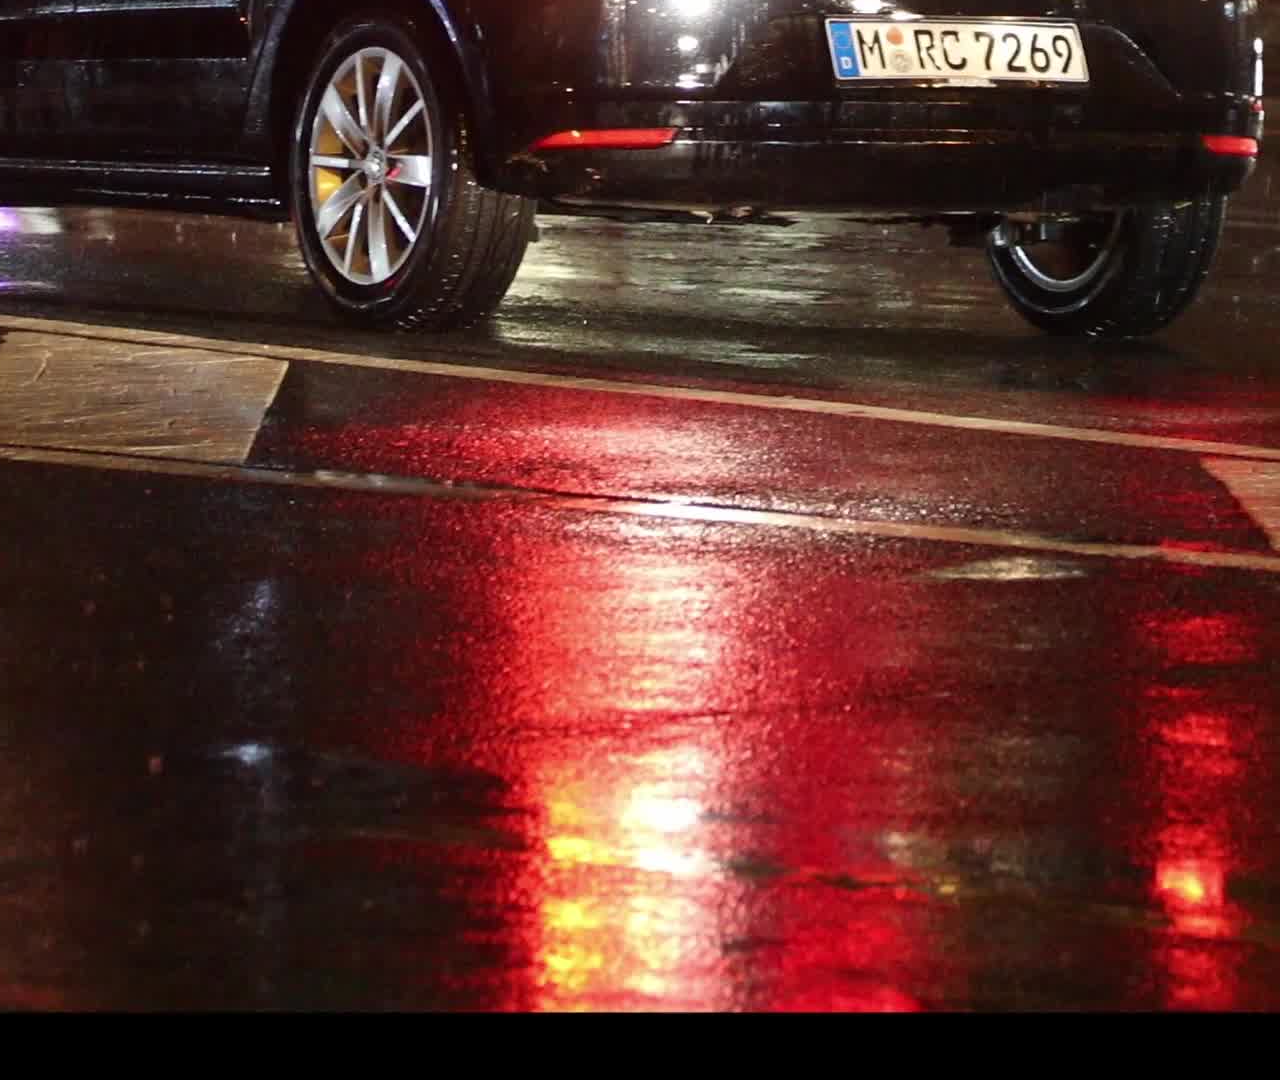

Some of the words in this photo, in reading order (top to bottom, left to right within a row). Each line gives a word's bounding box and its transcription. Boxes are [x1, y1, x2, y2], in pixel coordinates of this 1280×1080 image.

[856, 29, 886, 70] M
[913, 29, 968, 71] RC
[974, 31, 1073, 74] 7269
